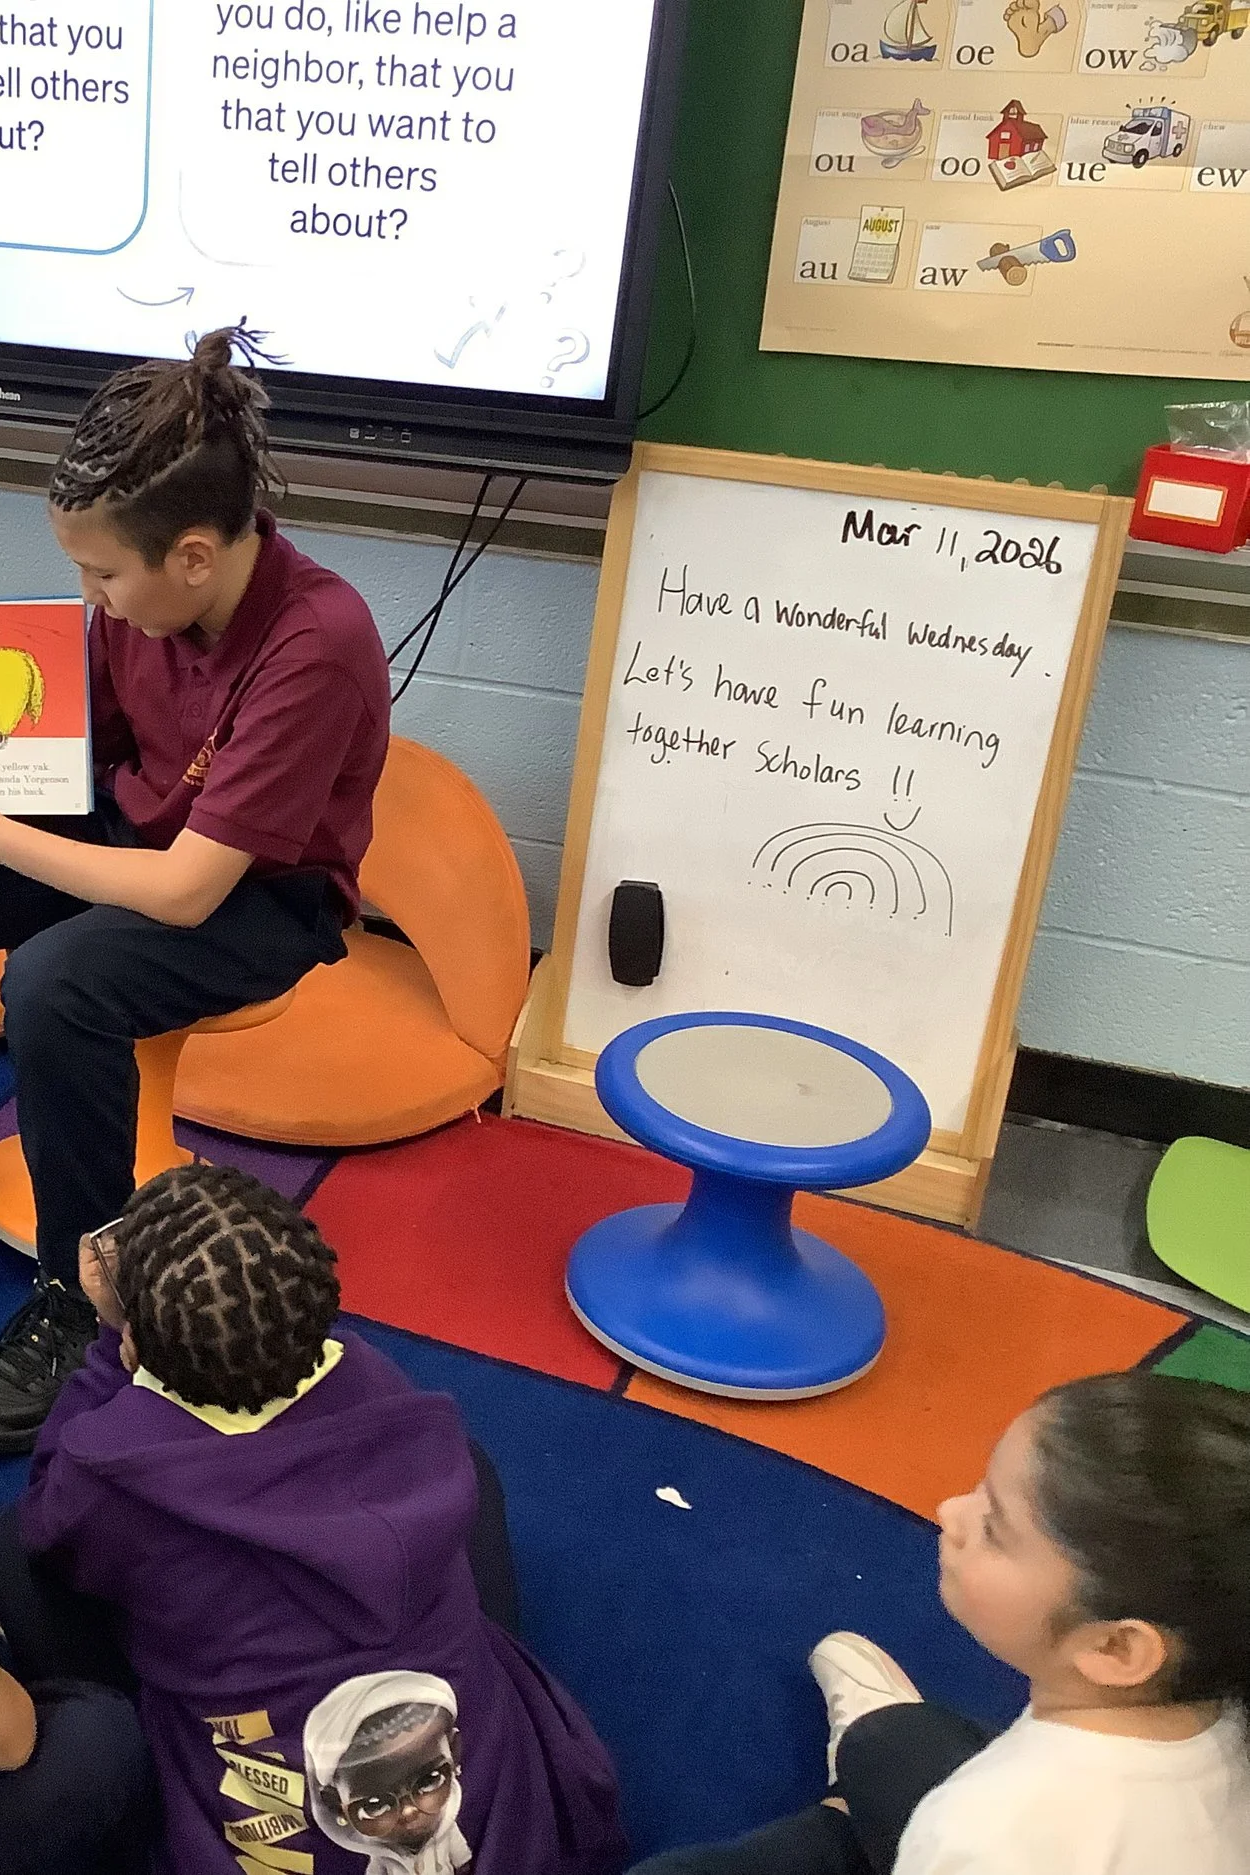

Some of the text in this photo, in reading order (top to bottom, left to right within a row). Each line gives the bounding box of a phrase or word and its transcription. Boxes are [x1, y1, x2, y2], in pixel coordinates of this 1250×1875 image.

[216, 0, 517, 45] you do, like help a
[68, 24, 123, 56] you
[831, 42, 869, 63] oa
[956, 44, 995, 66] oe
[1085, 48, 1138, 70] ow
[213, 48, 514, 98] neighbor, that you
[31, 70, 130, 104] others
[221, 98, 496, 144] that you want to
[268, 152, 437, 192] tell others
[815, 152, 855, 173] ou
[940, 156, 981, 177] oo
[1067, 161, 1107, 182] ue
[1197, 165, 1248, 188] ew
[290, 203, 409, 240] about?
[862, 218, 900, 234] AUGUST
[800, 260, 838, 281] au
[919, 266, 969, 287] aw
[840, 510, 922, 547] Mar
[974, 530, 1062, 574] 2026
[659, 565, 733, 617] Have
[744, 597, 761, 624] a
[623, 641, 1000, 768] Let's have fun learning
[627, 712, 735, 765] together
[755, 740, 861, 792] Scholars
[2, 762, 30, 772] yellow
[24, 775, 69, 785] Yorgenson
[8, 787, 21, 796] his
